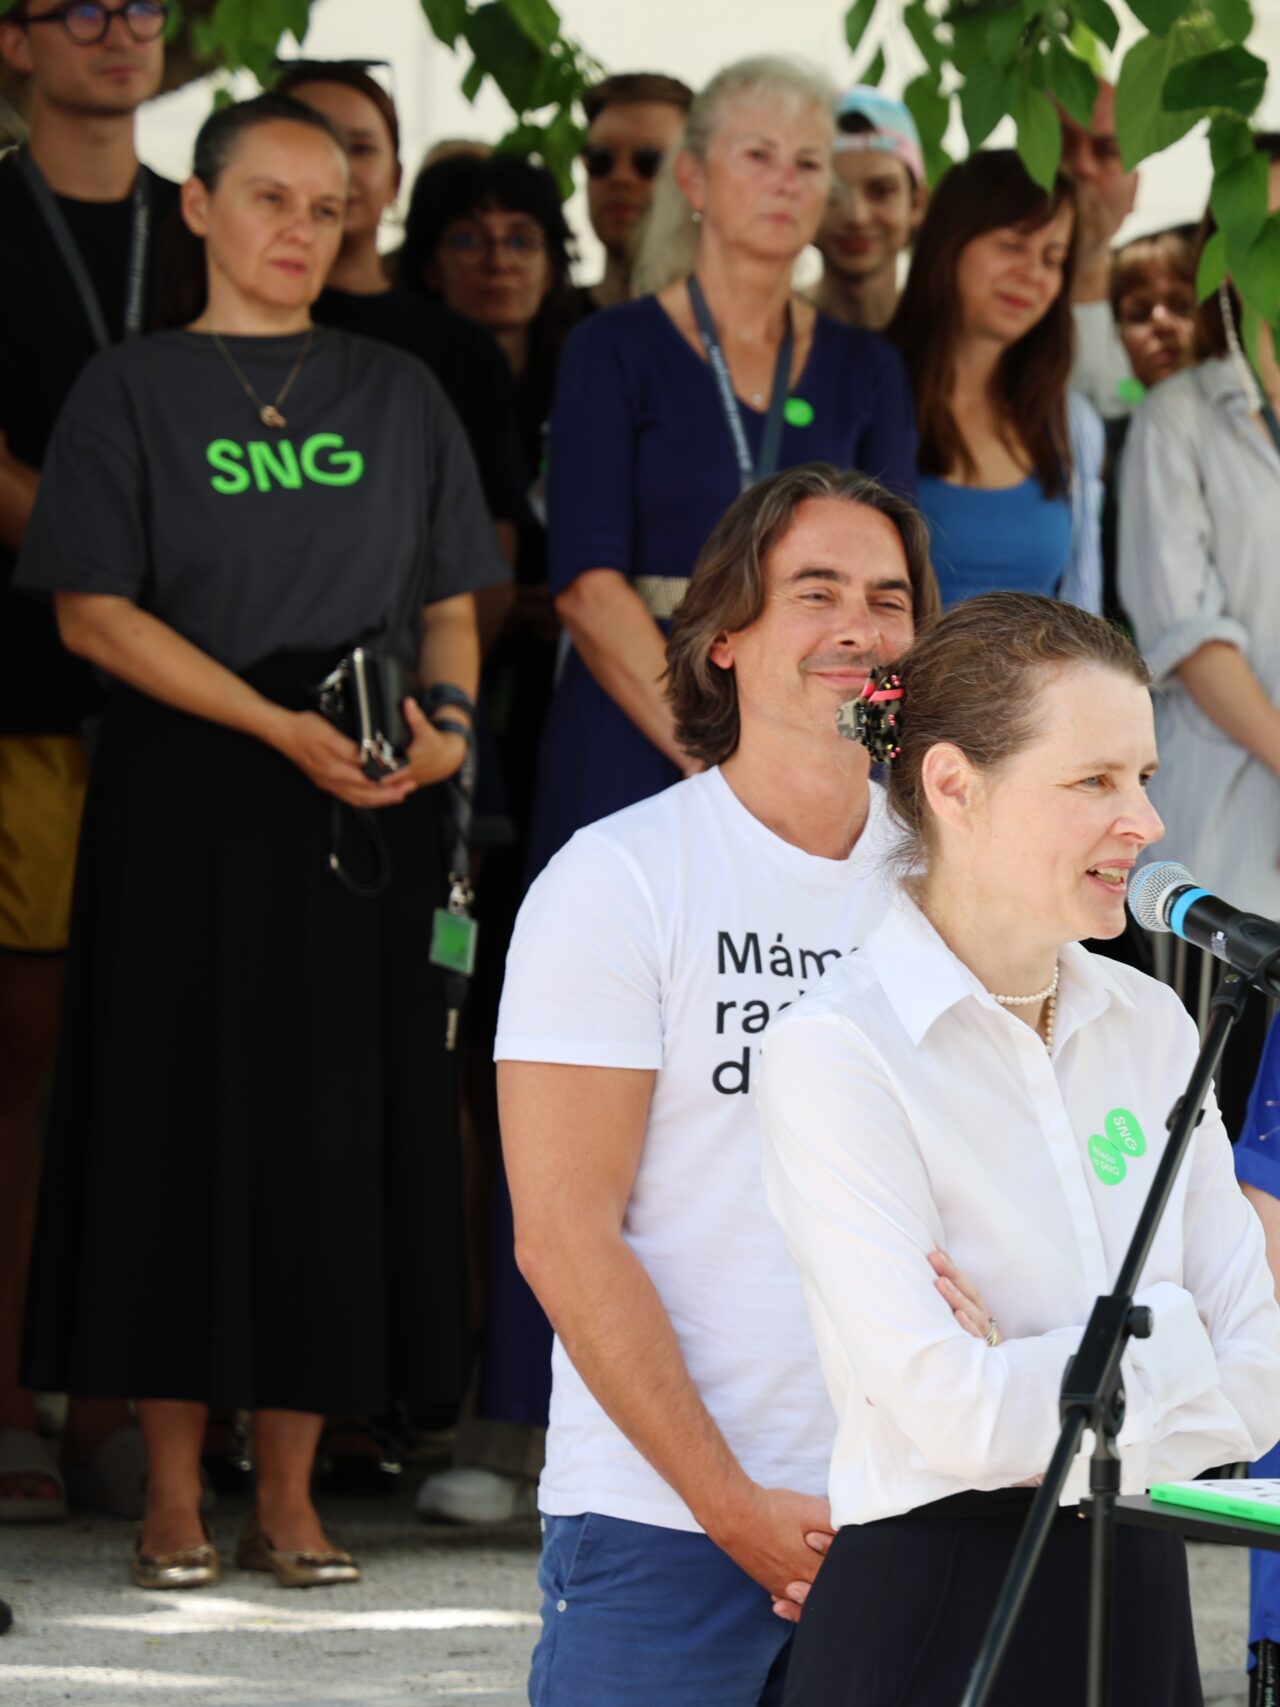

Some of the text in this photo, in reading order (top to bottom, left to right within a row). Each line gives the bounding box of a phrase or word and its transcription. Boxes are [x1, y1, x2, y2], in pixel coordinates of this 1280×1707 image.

[206, 432, 365, 495] SNG
[717, 930, 858, 979] Mám
[716, 987, 805, 1034] ra
[1112, 1115, 1139, 1150] SNG
